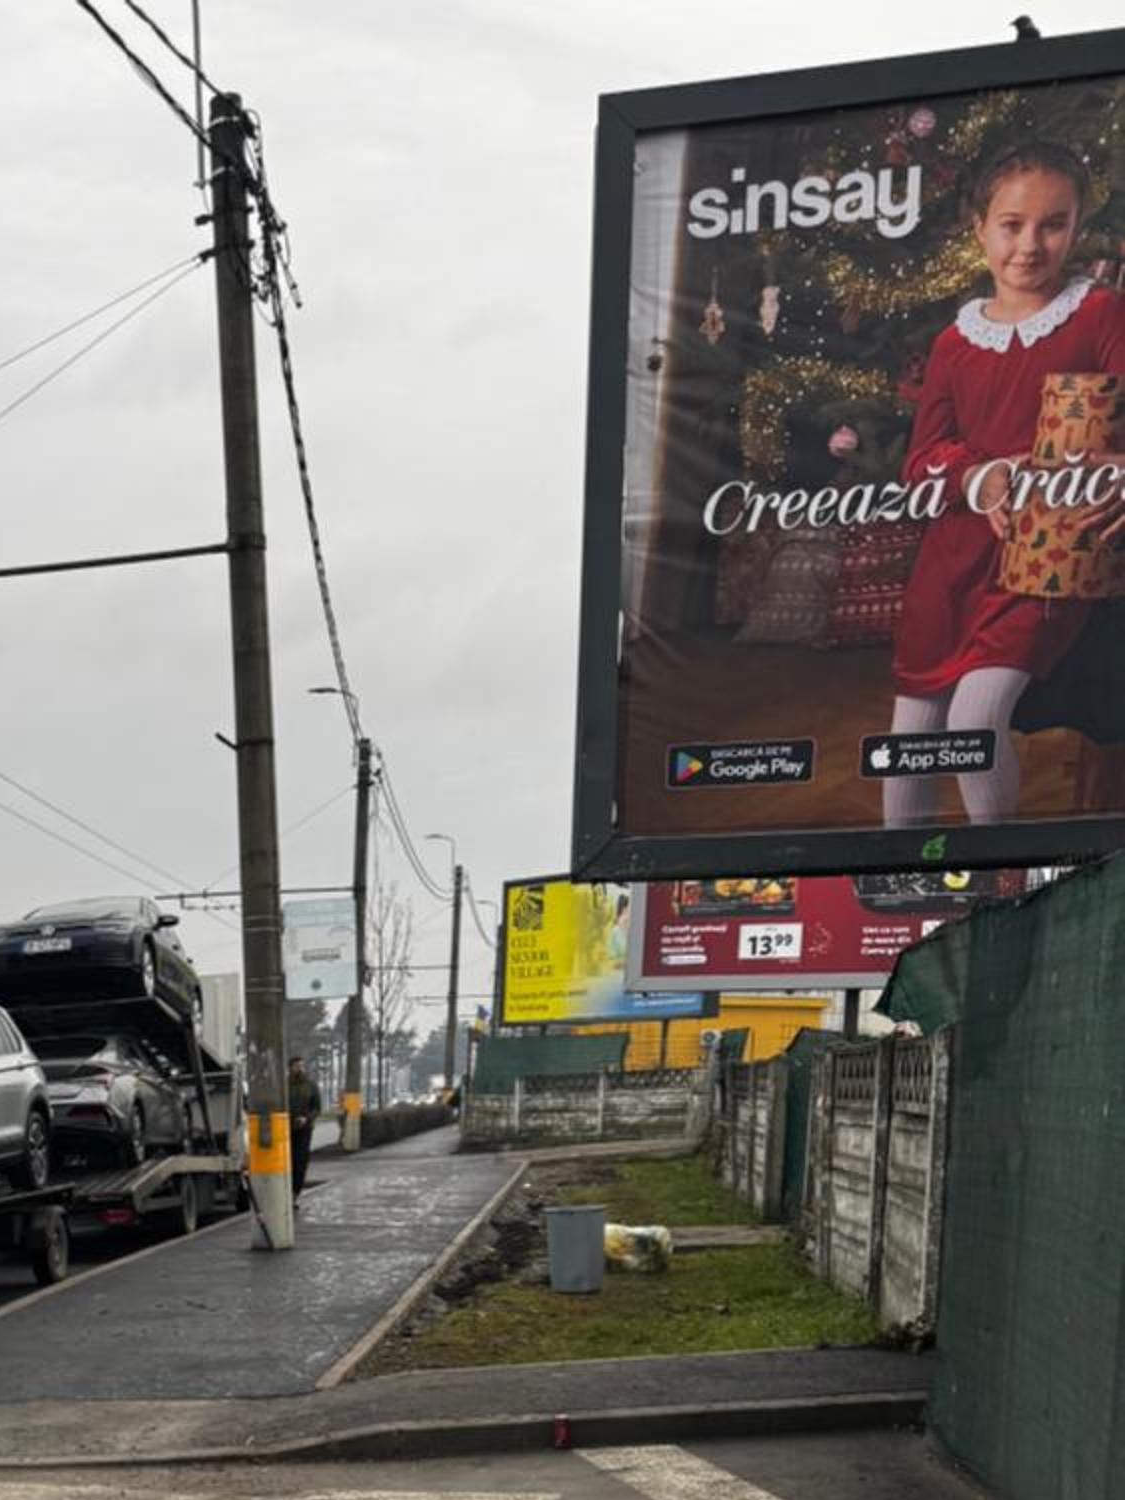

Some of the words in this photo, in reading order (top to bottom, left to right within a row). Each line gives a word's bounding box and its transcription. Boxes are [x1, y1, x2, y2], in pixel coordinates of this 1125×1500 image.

[687, 165, 923, 239] sinsay
[703, 463, 949, 536] Creează
[967, 450, 1125, 514] Crăc
[709, 758, 768, 780] Google
[770, 757, 804, 777] Play
[897, 751, 935, 771] App
[937, 749, 986, 767] Store
